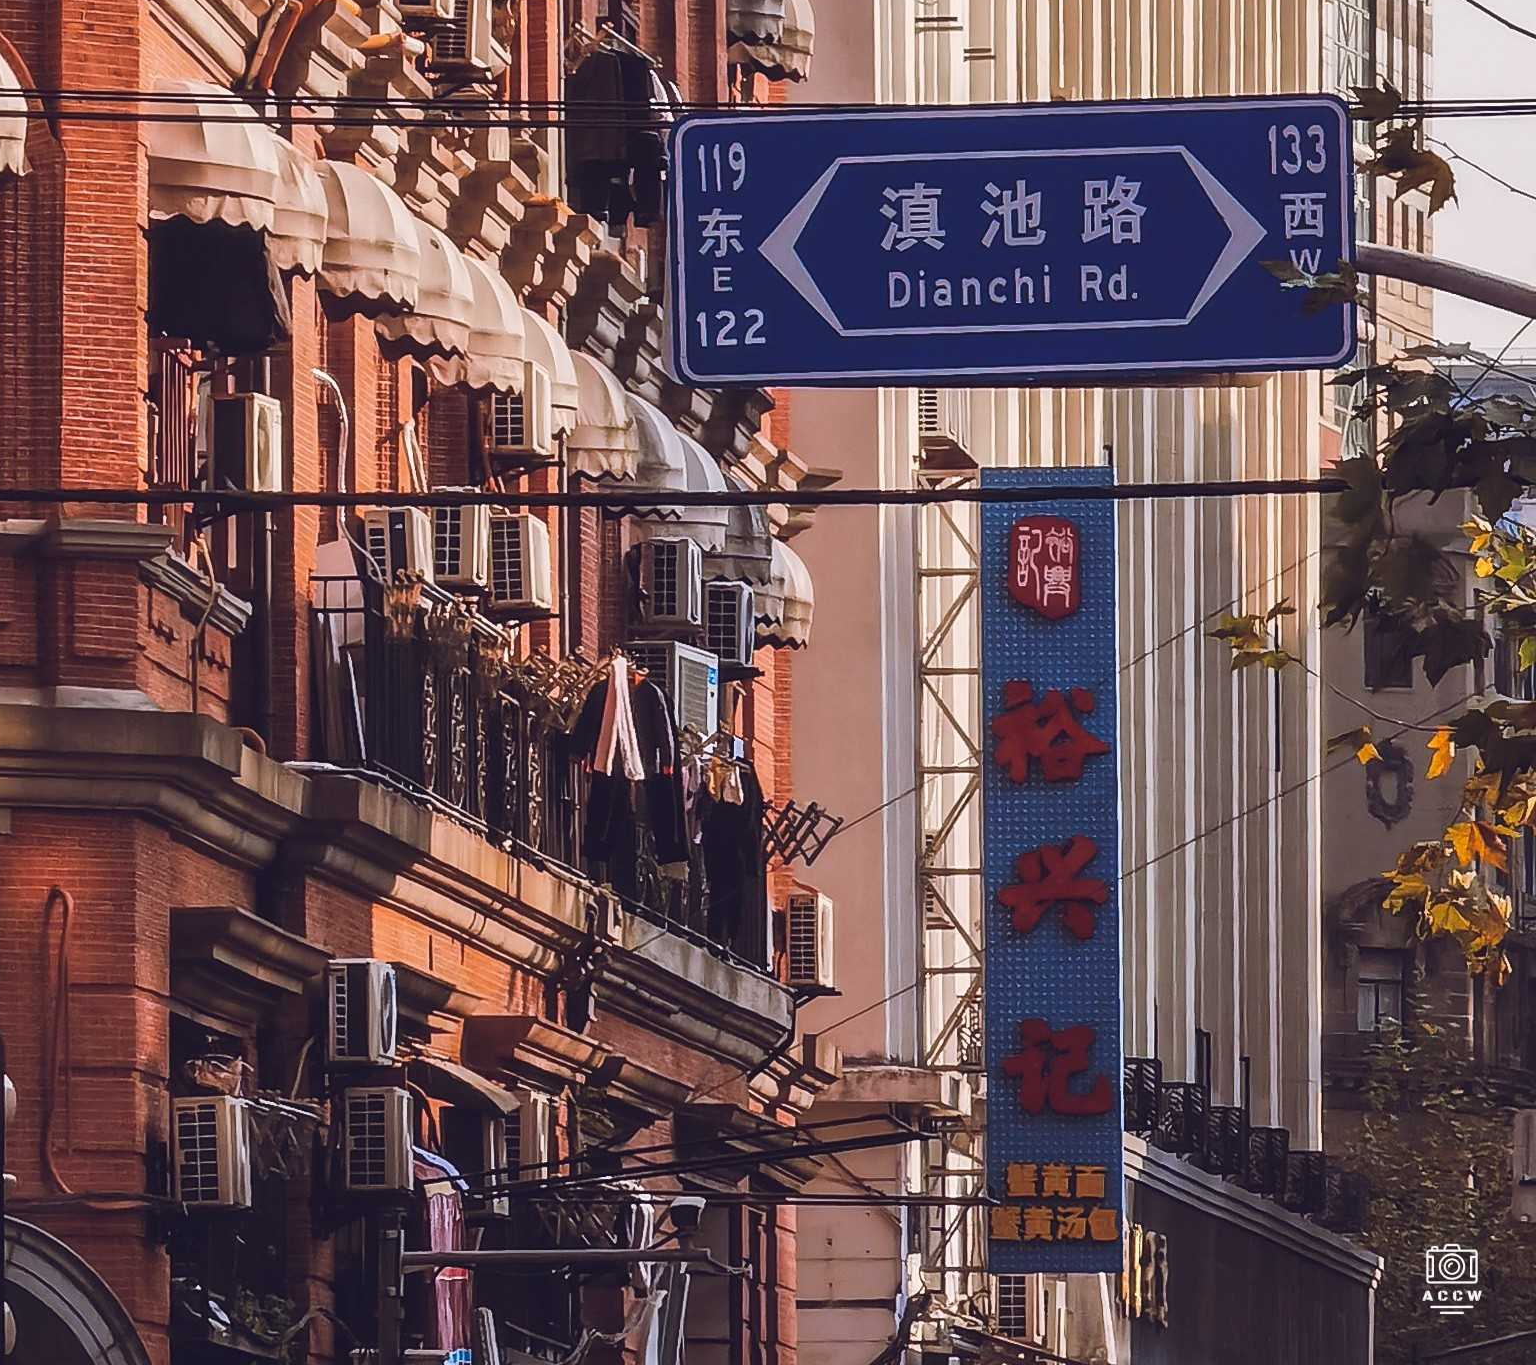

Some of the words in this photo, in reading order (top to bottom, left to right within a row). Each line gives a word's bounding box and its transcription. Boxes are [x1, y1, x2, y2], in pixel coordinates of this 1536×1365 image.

[697, 141, 747, 193] 119
[1268, 124, 1327, 175] 133
[697, 207, 745, 259] 东
[878, 174, 1148, 253] 滇池路
[1279, 192, 1328, 240] 西
[712, 266, 733, 293] E
[888, 263, 1052, 309] Dianchi
[1079, 263, 1139, 302] Rd.
[1289, 248, 1323, 275] W
[695, 307, 767, 348] 122
[990, 679, 1113, 1117] 裕兴记
